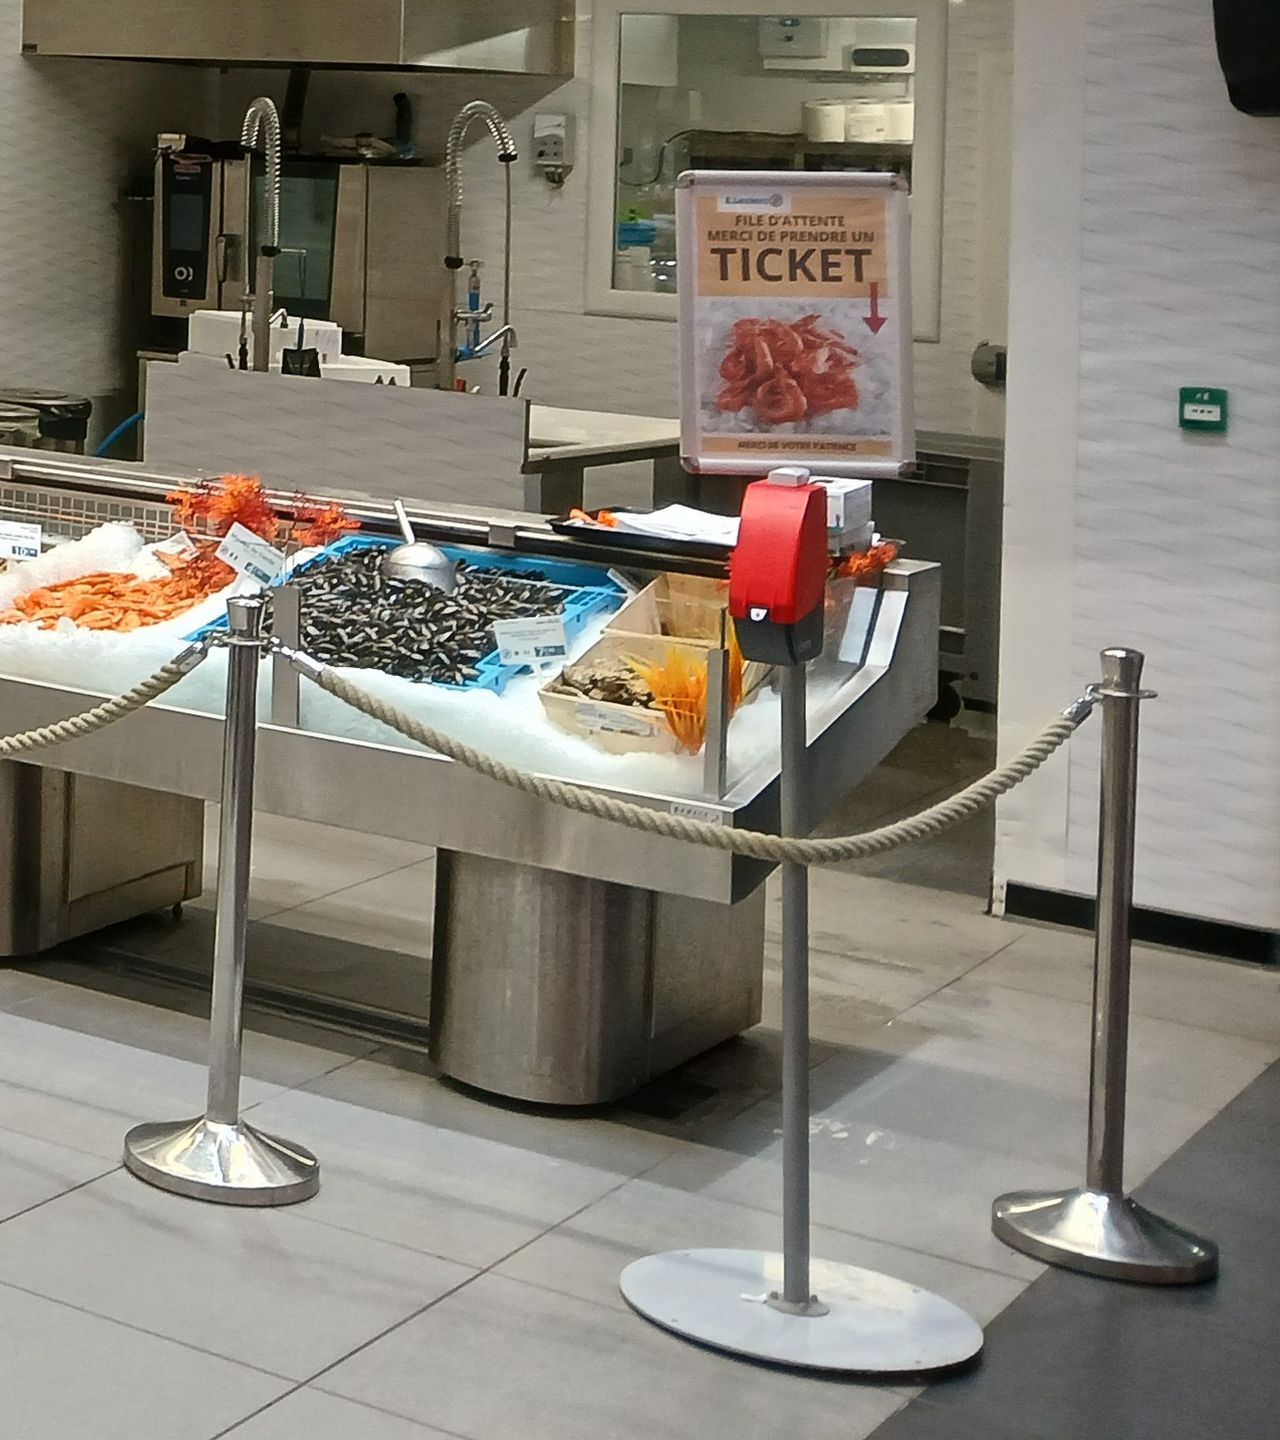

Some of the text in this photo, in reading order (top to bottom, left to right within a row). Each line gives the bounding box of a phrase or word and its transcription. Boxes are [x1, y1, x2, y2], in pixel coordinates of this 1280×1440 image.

[735, 215, 845, 227] FILE D'ATTENTE
[707, 230, 875, 243] MERCI DE PRENDRE UN
[710, 247, 873, 283] TICKET
